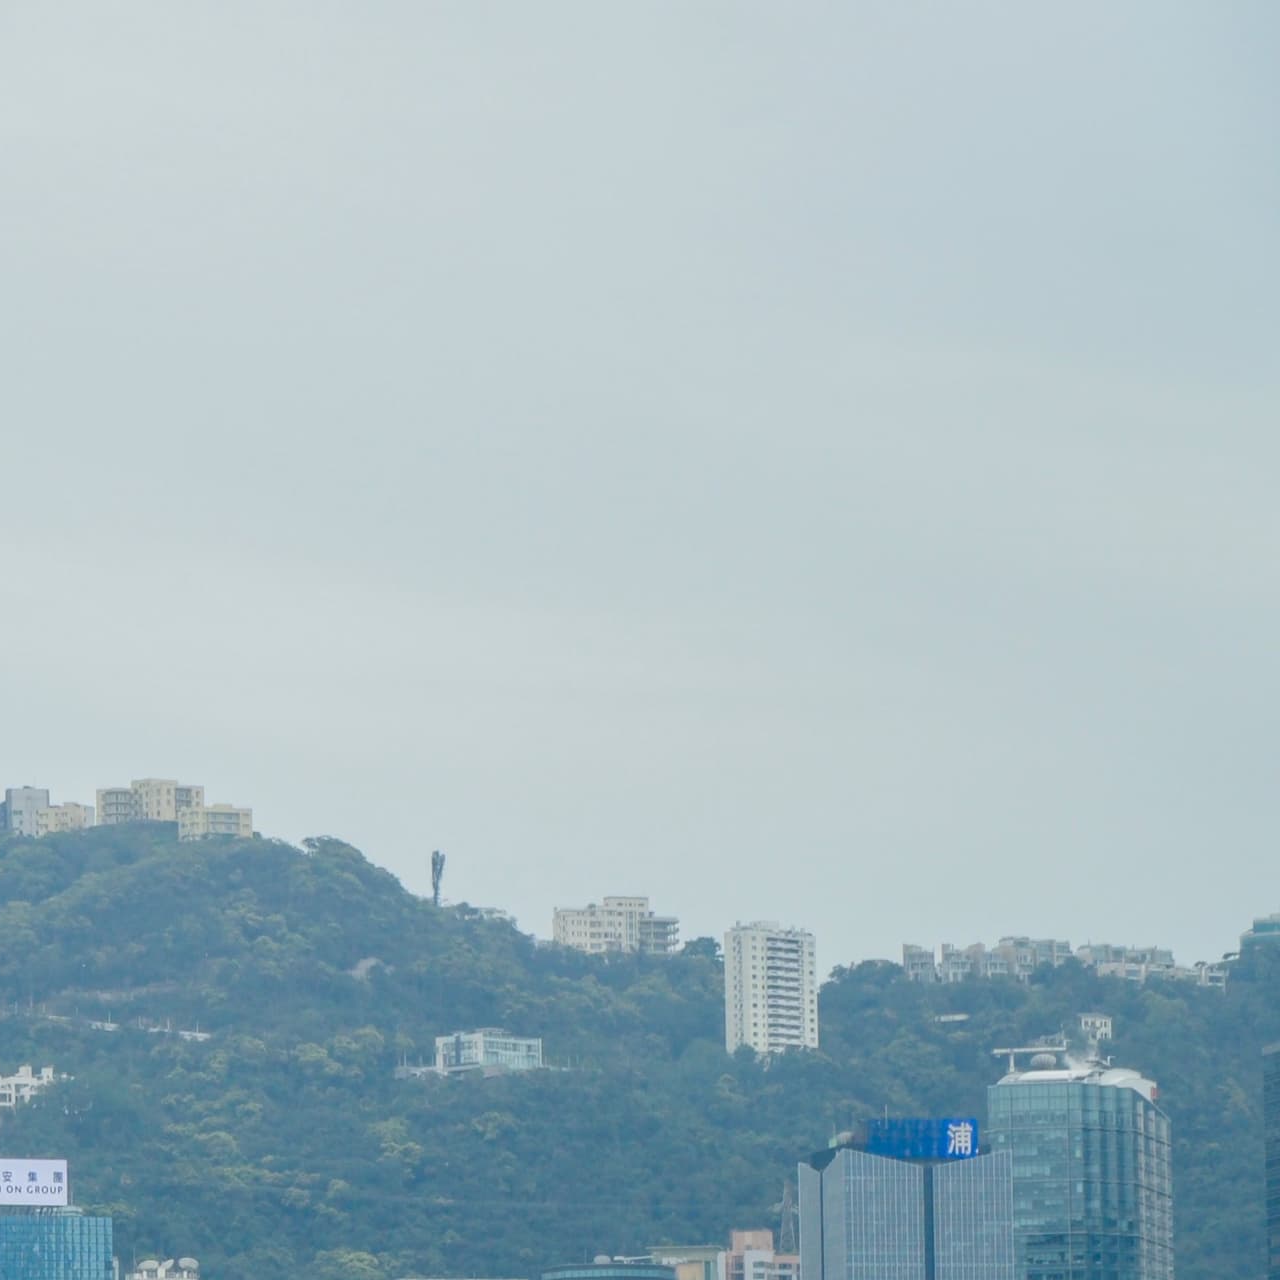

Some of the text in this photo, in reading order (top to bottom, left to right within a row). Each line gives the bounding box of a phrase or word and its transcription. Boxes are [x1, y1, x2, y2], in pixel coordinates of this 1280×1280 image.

[946, 1121, 979, 1156] 浦
[6, 1185, 23, 1194] ON
[26, 1185, 64, 1195] GROUP
